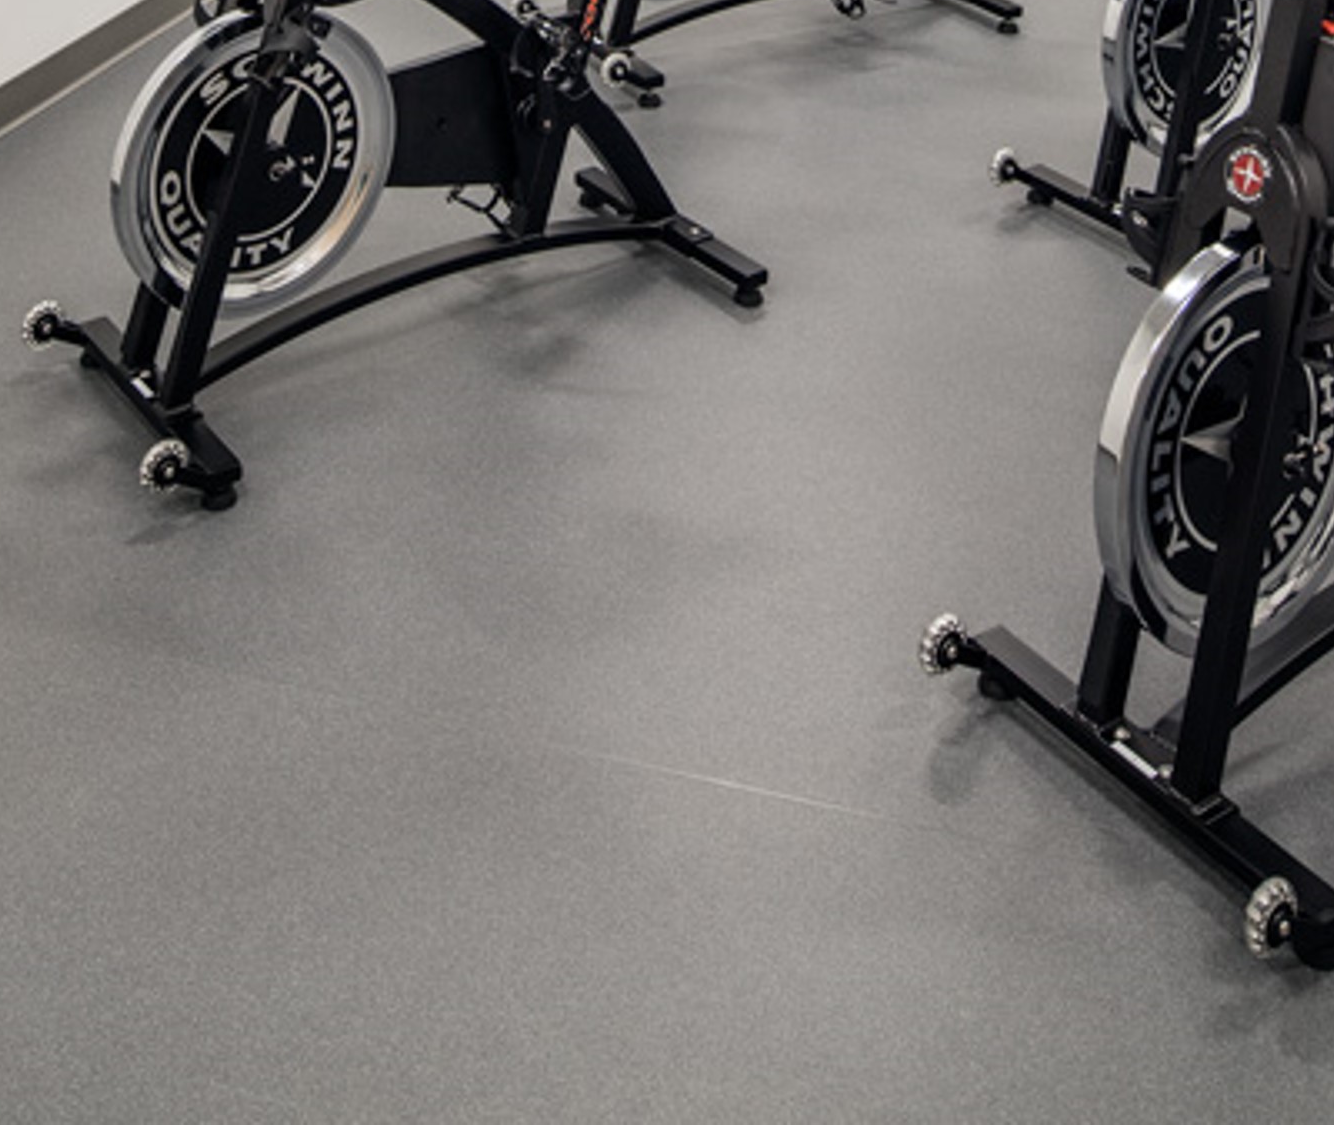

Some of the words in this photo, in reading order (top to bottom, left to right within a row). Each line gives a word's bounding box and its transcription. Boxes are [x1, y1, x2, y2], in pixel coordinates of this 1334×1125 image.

[199, 52, 354, 169] SCWINN
[160, 170, 295, 268] QUAITY
[1150, 315, 1234, 558] QUALITY
